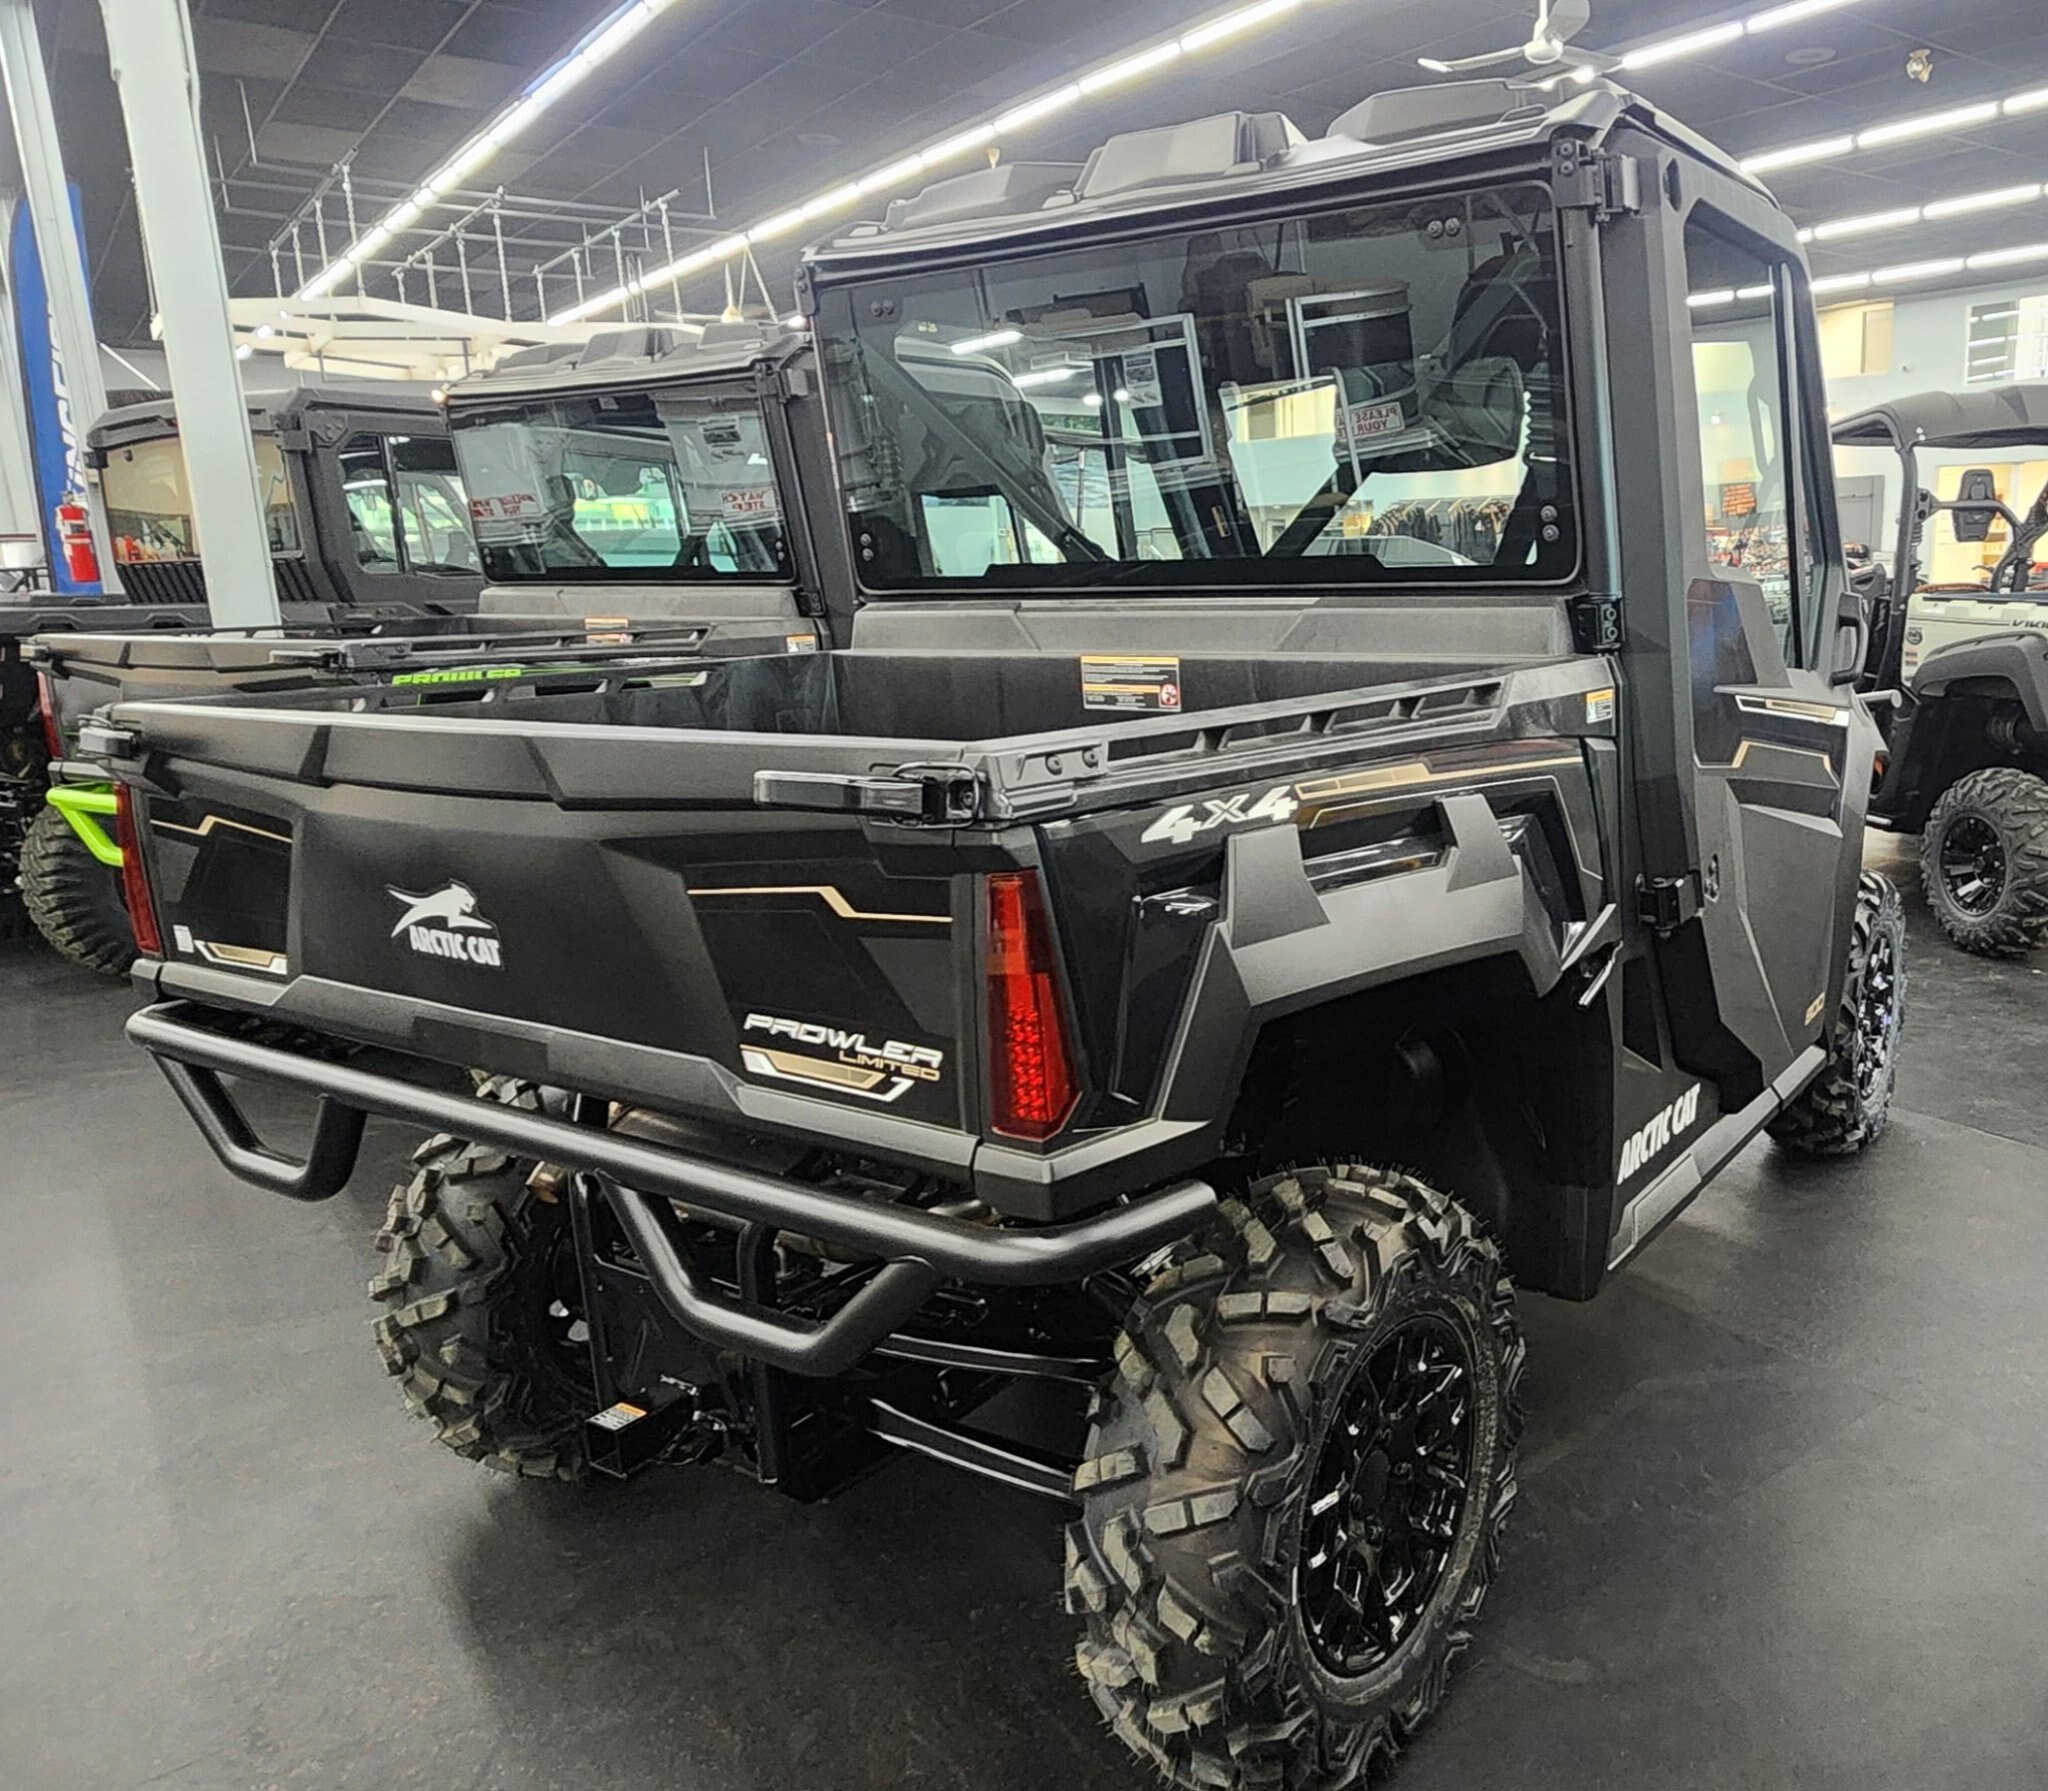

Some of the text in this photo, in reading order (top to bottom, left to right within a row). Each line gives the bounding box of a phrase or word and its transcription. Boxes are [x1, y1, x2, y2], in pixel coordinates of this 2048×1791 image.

[2012, 619, 2048, 630] VIKI
[409, 924, 501, 967] ARCTIC CAT
[743, 1013, 944, 1069] PROWLER
[838, 1050, 941, 1082] LIMITED
[1616, 1082, 1701, 1186] ARCTIC CAT
